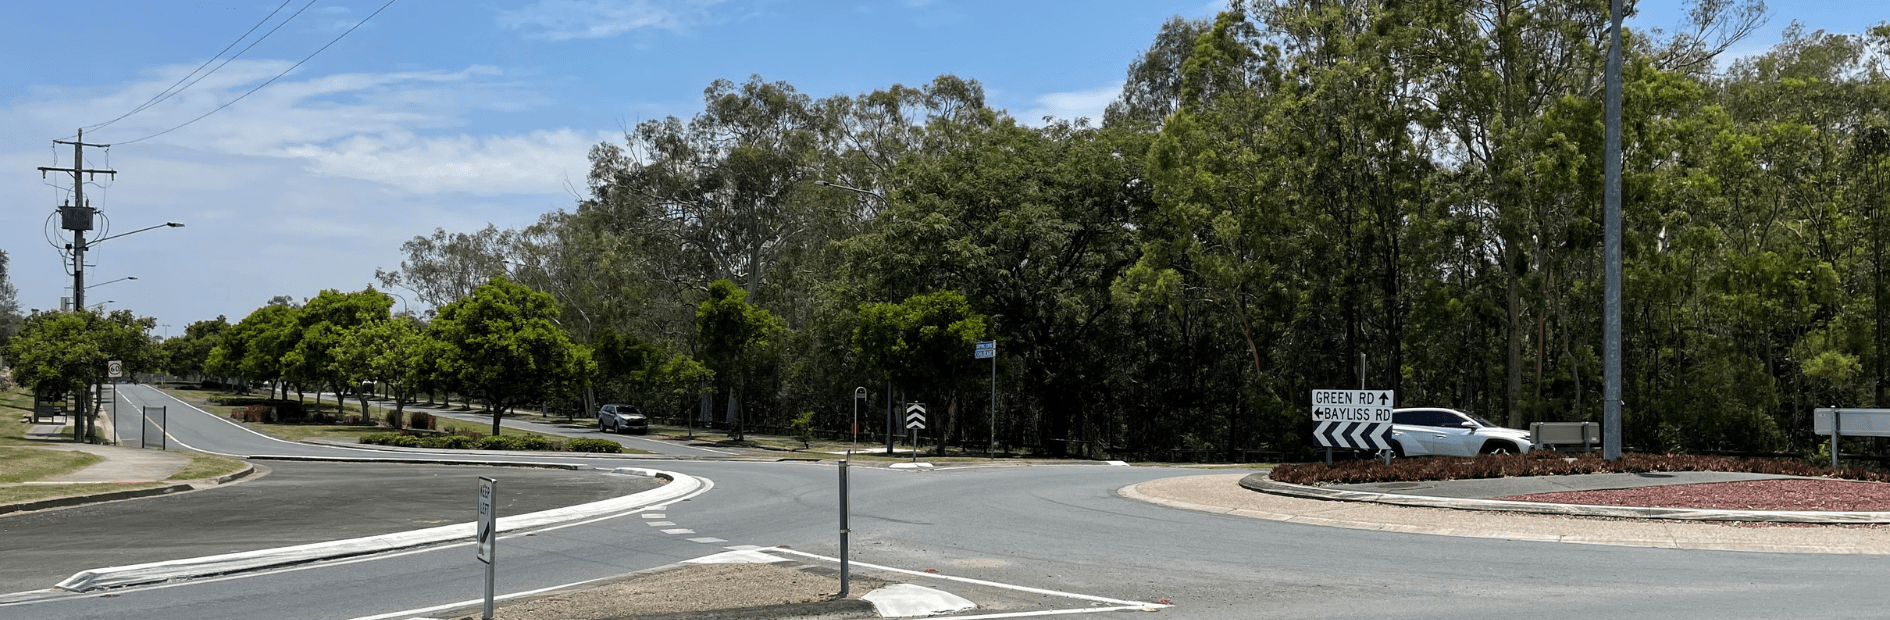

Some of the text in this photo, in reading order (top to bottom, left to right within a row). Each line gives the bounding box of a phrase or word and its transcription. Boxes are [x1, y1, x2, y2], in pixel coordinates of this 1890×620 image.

[1316, 392, 1374, 405] GREEN RD
[1324, 407, 1391, 421] BAYLISS RD
[480, 484, 490, 499] KEEP
[480, 502, 489, 516] LEFT
